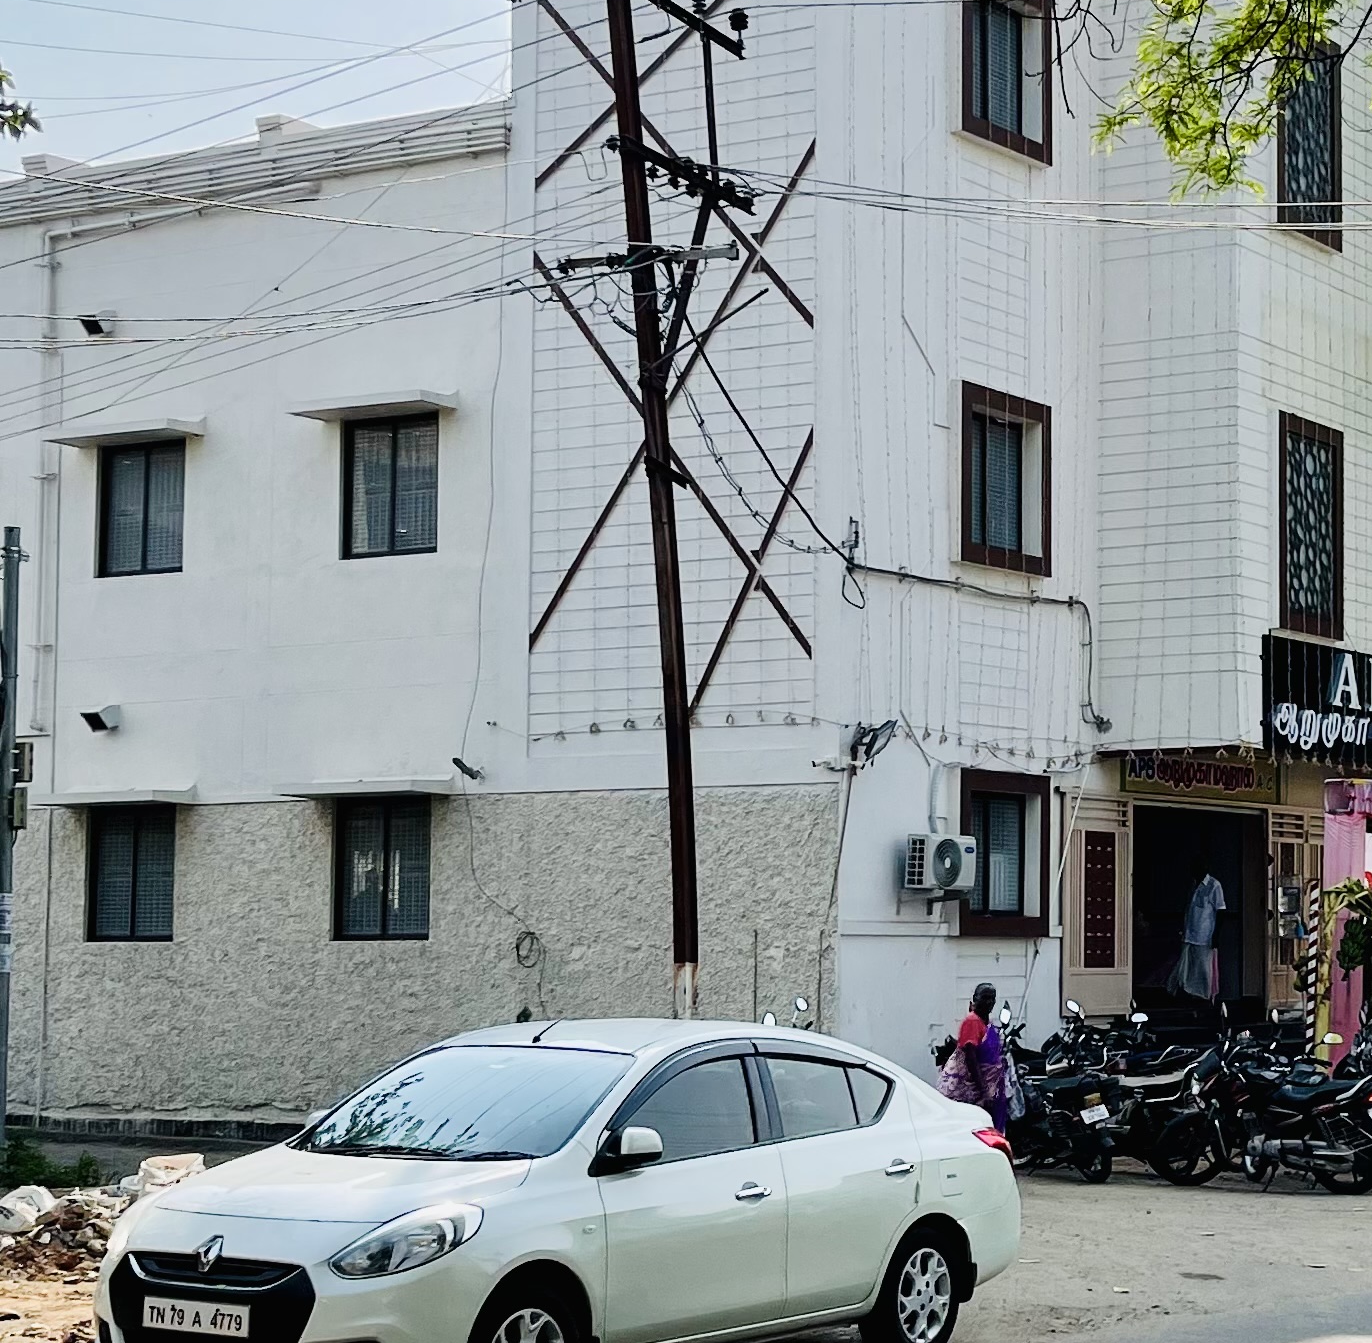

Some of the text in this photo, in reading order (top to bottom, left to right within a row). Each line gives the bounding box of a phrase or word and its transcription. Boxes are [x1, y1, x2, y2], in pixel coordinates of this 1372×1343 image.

[1274, 702, 1371, 751] ஆறுமுகா
[1127, 756, 1156, 781] APS
[148, 1305, 243, 1332] TN 79 A 4779
